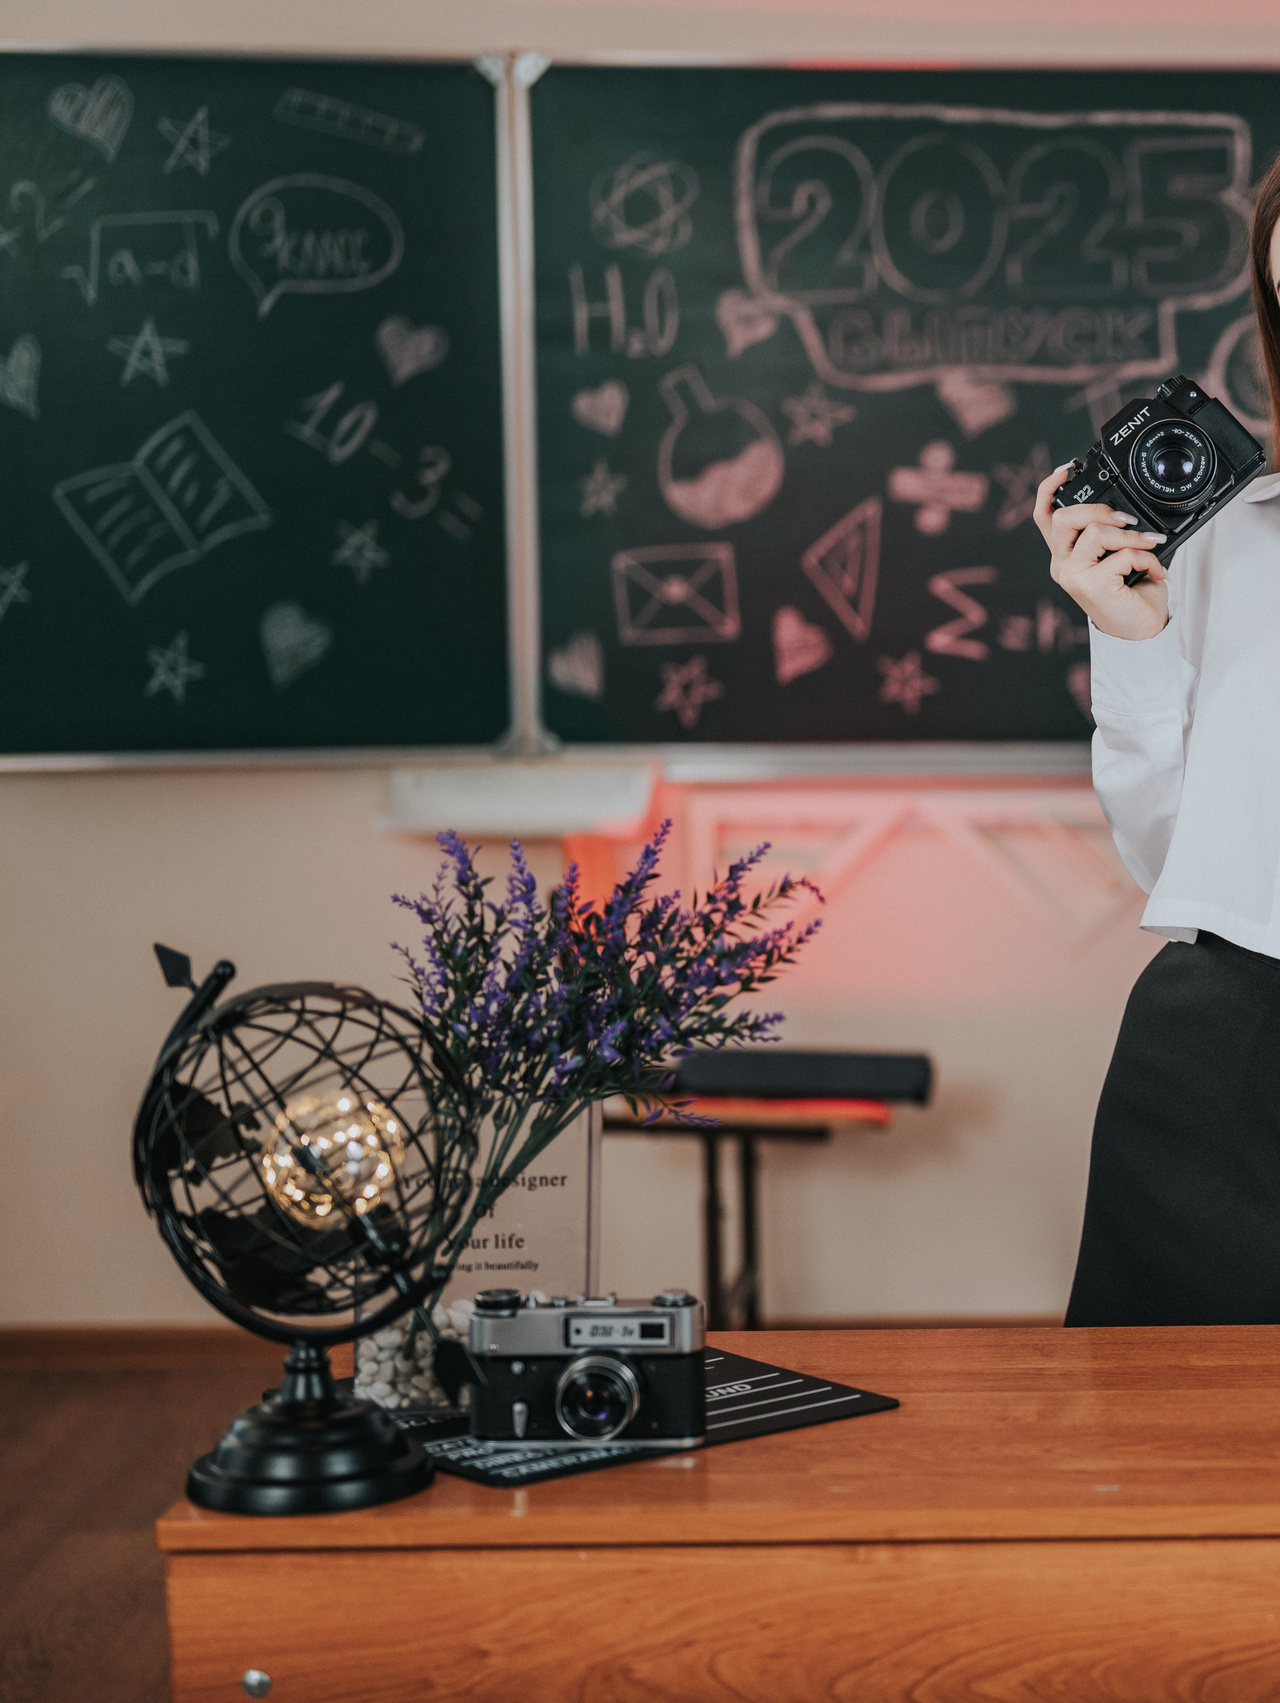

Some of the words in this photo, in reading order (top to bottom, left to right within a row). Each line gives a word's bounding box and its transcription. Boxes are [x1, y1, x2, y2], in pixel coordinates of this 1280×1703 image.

[757, 134, 1252, 302] 2025
[1109, 406, 1152, 447] ZENIT
[1184, 431, 1202, 448] ZENIT
[1073, 485, 1095, 504] 122
[494, 1233, 525, 1250] life
[484, 1260, 540, 1274] beautifully
[704, 1384, 752, 1398] UND
